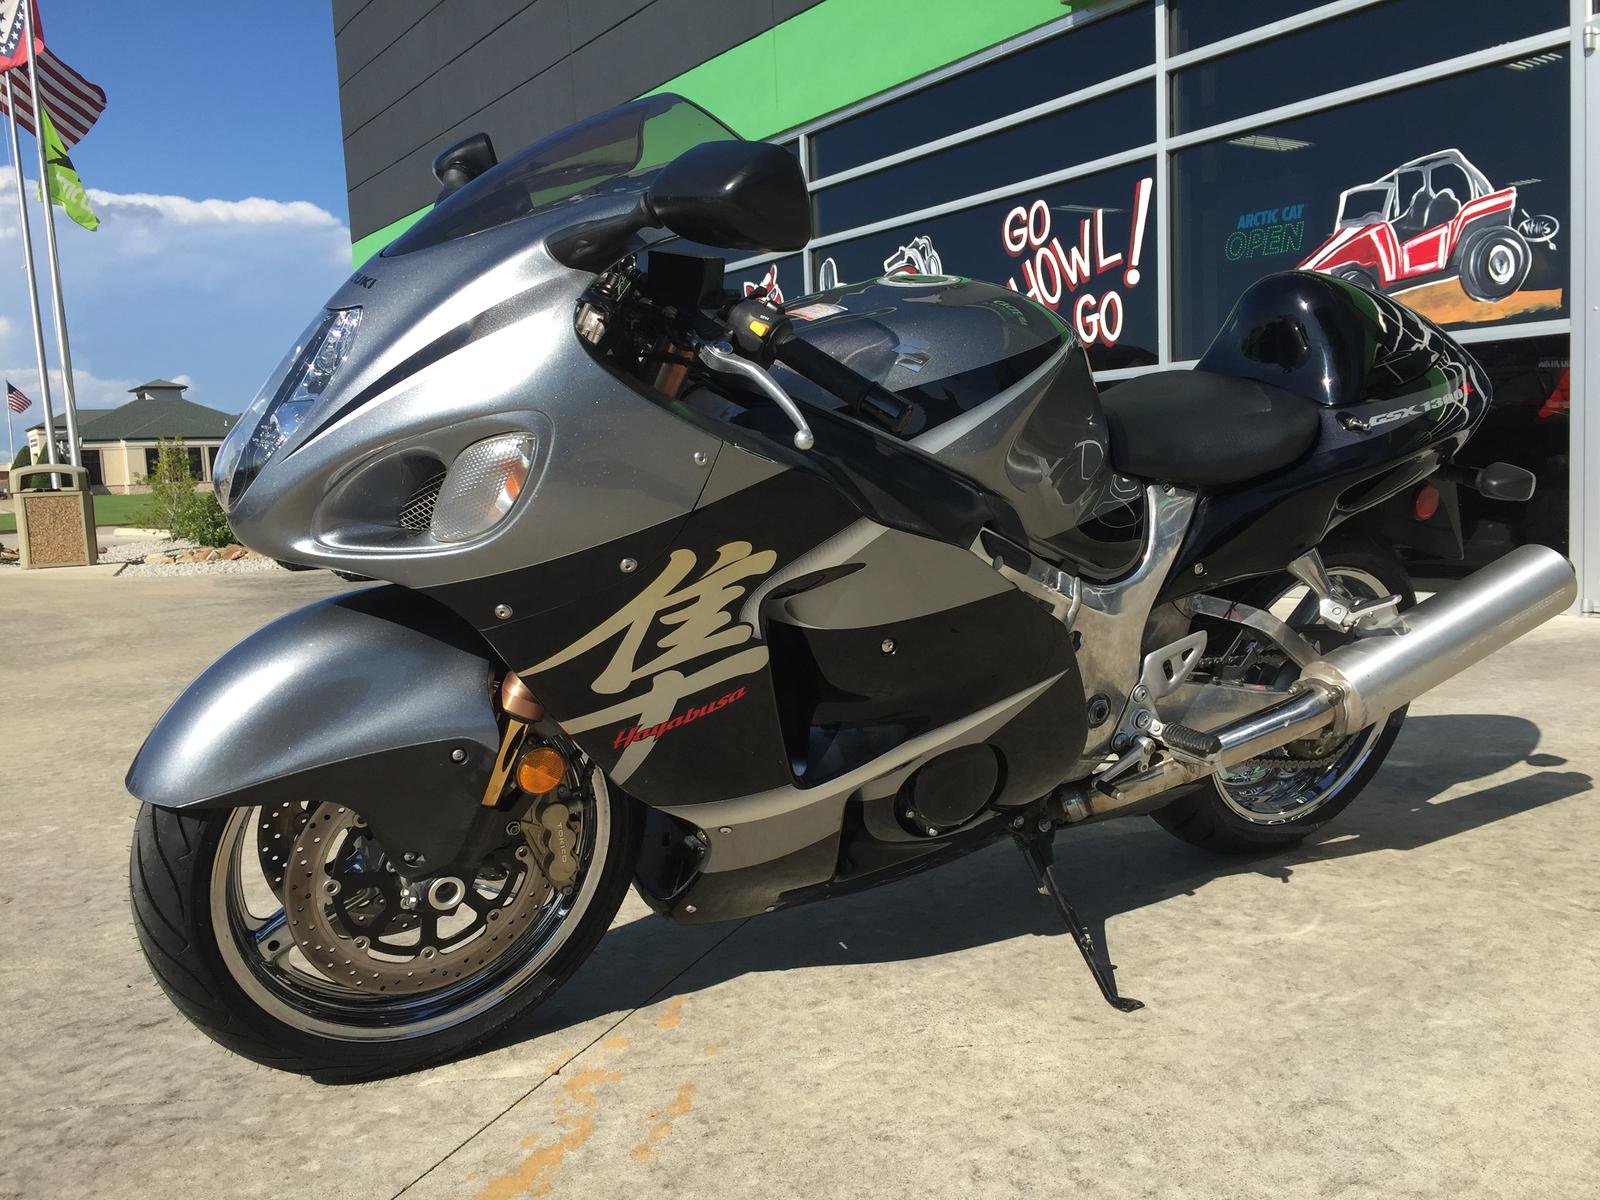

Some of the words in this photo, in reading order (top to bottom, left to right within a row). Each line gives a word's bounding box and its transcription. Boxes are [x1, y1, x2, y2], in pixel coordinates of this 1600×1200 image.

[1002, 200, 1050, 257] GO
[1225, 220, 1305, 261] OPEN
[1237, 208, 1280, 230] ARCTIC
[1281, 204, 1304, 221] CAT
[1073, 291, 1123, 348] GO
[1369, 405, 1422, 427] GSX
[613, 687, 746, 750] Hayabusa
